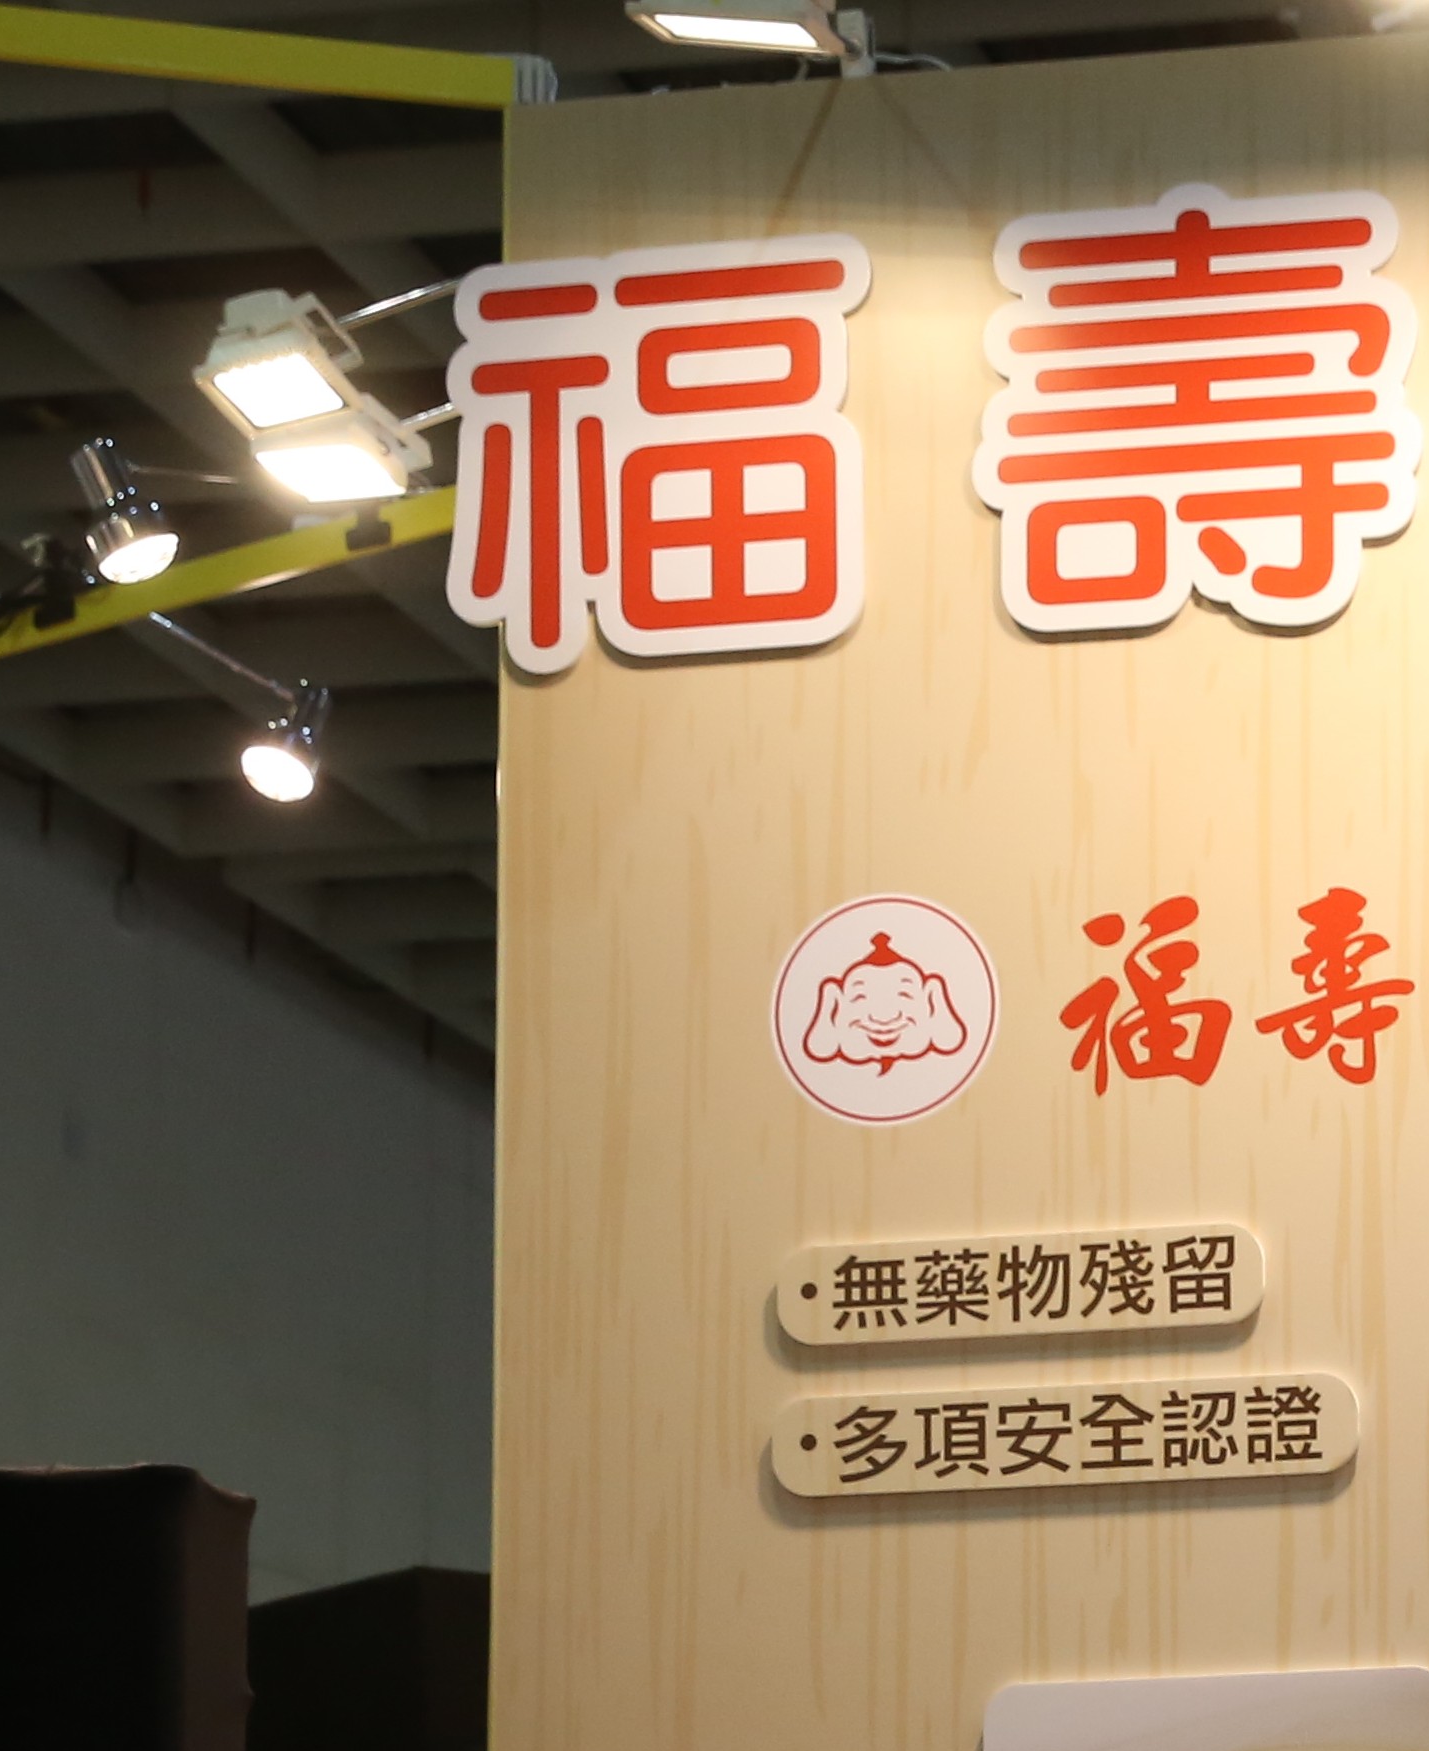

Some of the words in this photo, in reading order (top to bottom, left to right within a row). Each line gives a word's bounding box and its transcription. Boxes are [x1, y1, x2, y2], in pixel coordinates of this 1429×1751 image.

[831, 1232, 1238, 1332] 無藥物殘留
[833, 1382, 1325, 1482] 多項安全認證
